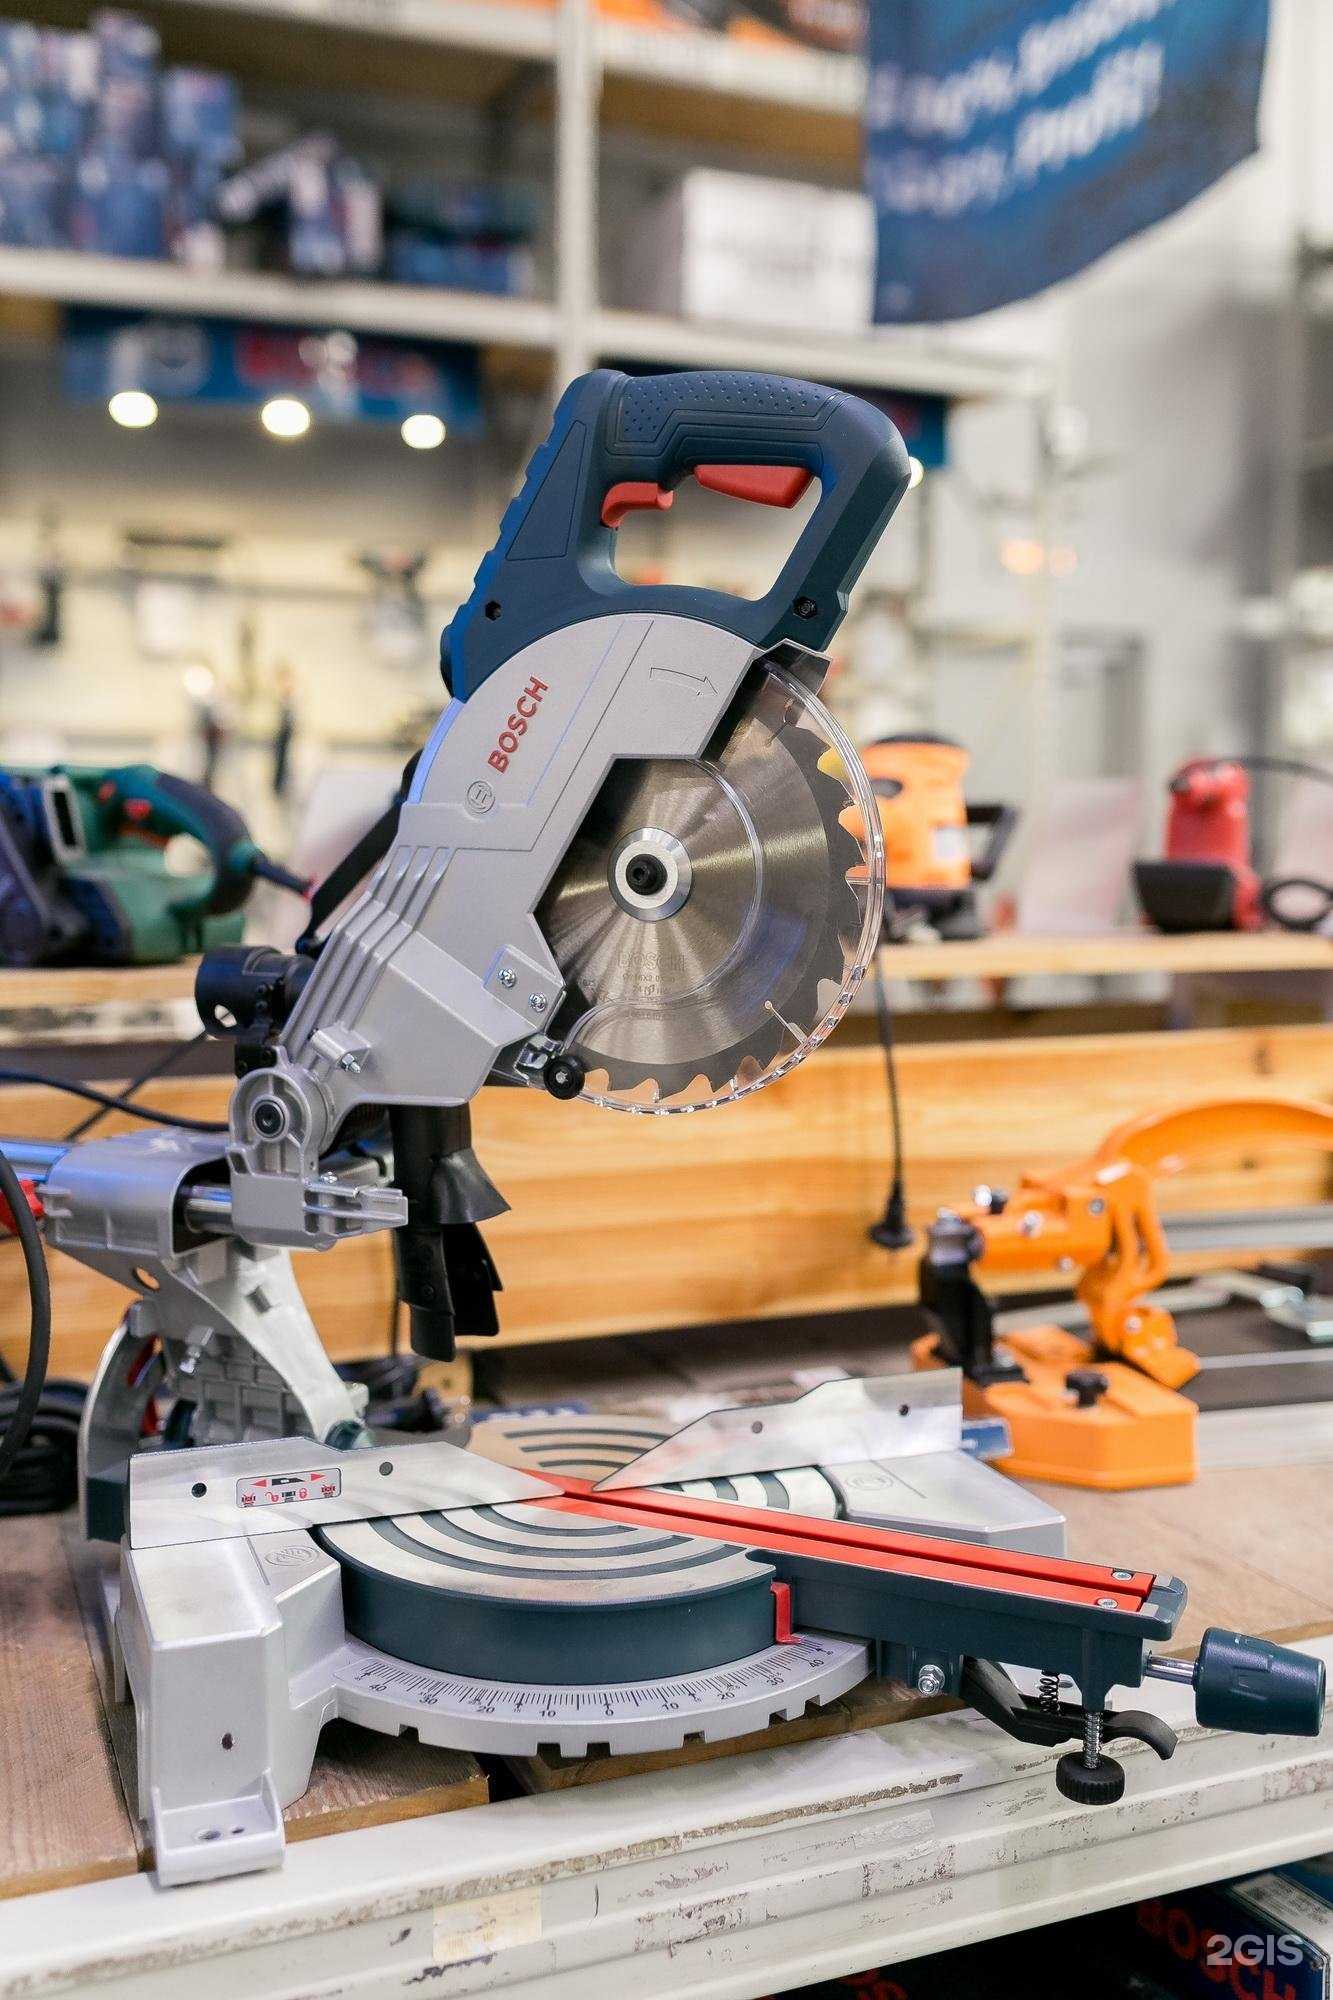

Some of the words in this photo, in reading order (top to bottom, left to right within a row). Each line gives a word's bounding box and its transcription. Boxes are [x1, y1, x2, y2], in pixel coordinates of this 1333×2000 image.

[487, 675, 549, 774] BOSCH
[476, 1705, 495, 1714] 20
[605, 1708, 614, 1716] 0
[662, 1702, 679, 1710] 10
[718, 1692, 735, 1700] 20
[766, 1677, 784, 1686] 30
[809, 1659, 824, 1668] 40
